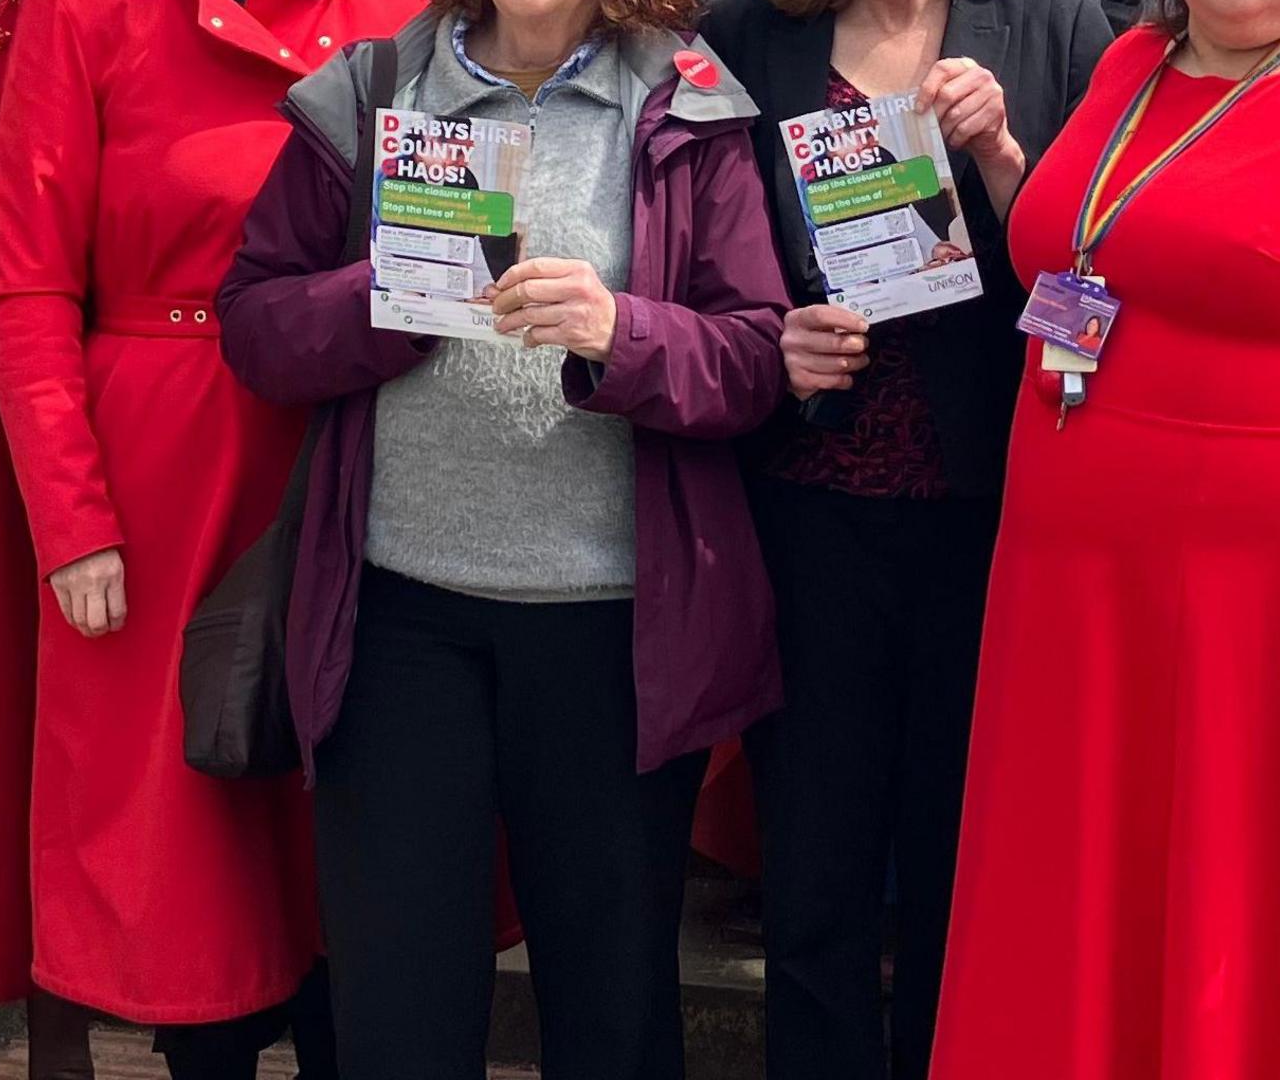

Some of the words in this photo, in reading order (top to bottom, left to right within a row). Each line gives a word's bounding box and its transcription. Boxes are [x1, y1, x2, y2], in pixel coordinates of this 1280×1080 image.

[382, 136, 475, 163] COUNTY
[794, 125, 880, 160] COUNTY
[380, 157, 465, 184] CHAOS!
[801, 147, 882, 181] CHAOS!
[383, 180, 406, 193] Stop
[407, 184, 423, 193] the
[461, 190, 471, 199] of
[807, 182, 829, 195] Stop
[830, 177, 846, 188] the
[847, 170, 880, 185] closure
[882, 166, 892, 177] of
[382, 202, 405, 214] Stop
[406, 205, 421, 214] the
[444, 210, 454, 218] of
[812, 201, 834, 215] Stop
[835, 196, 851, 207] the
[873, 190, 883, 200] of
[928, 272, 975, 293] UNISON
